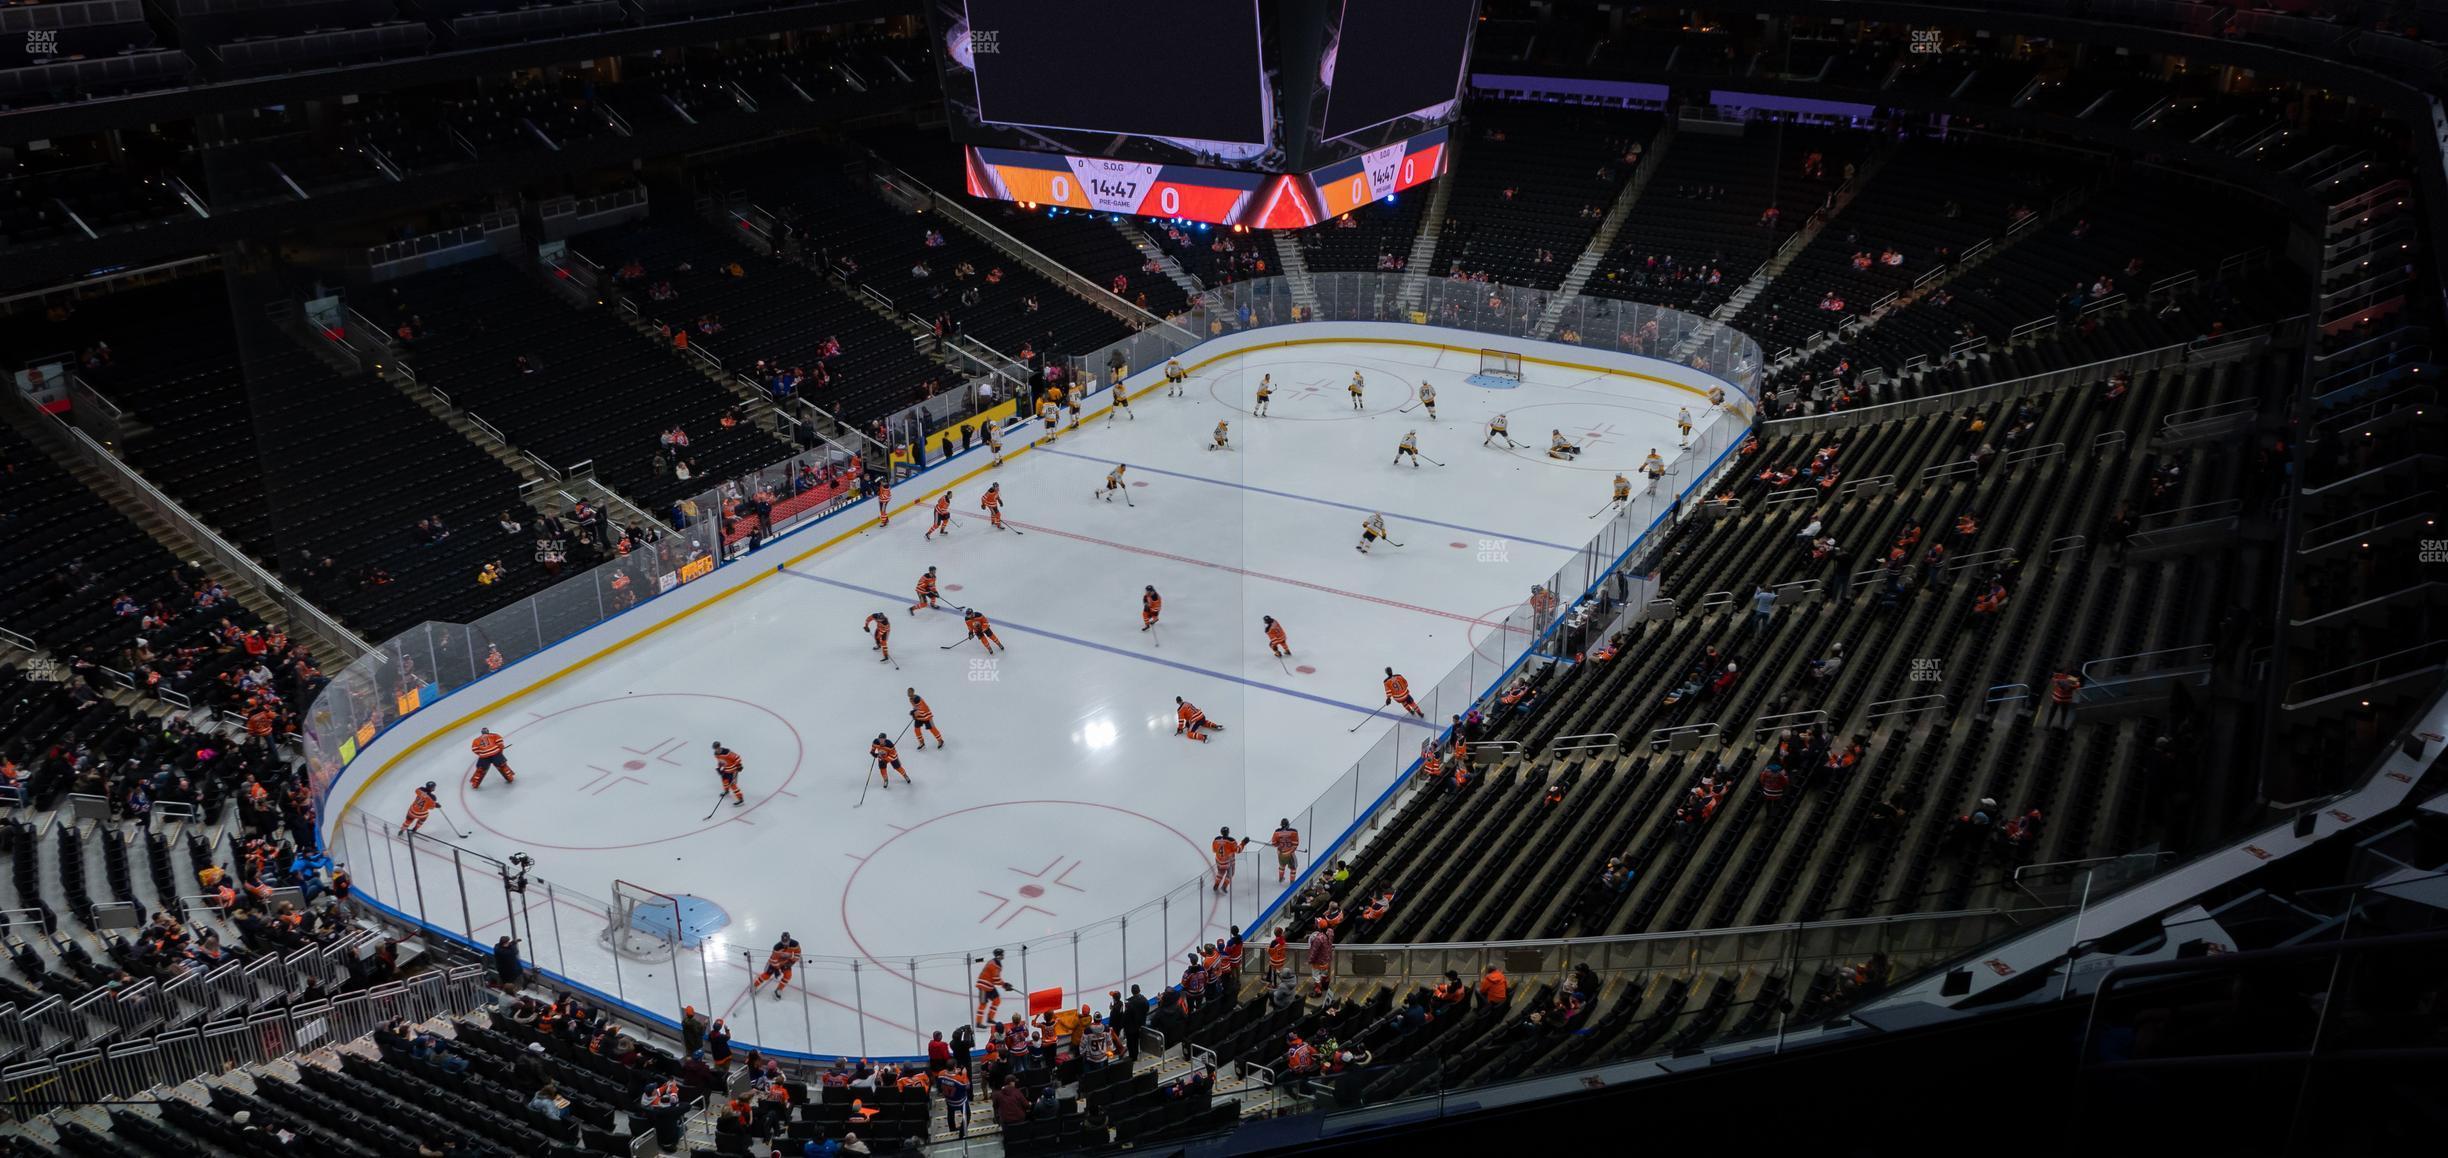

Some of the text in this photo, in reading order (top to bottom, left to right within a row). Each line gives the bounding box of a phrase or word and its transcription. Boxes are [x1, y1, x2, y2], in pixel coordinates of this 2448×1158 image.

[1373, 164, 1395, 187] 14:47
[1405, 158, 1414, 185] 0
[1052, 175, 1069, 203] 0
[1091, 178, 1137, 199] 14:47
[1352, 177, 1363, 205] 0
[1099, 198, 1131, 208] PRE-GAME
[1161, 186, 1180, 215] 0
[1392, 679, 1404, 691] 91
[1218, 844, 1224, 858] 4
[1091, 1039, 1105, 1053] 97
